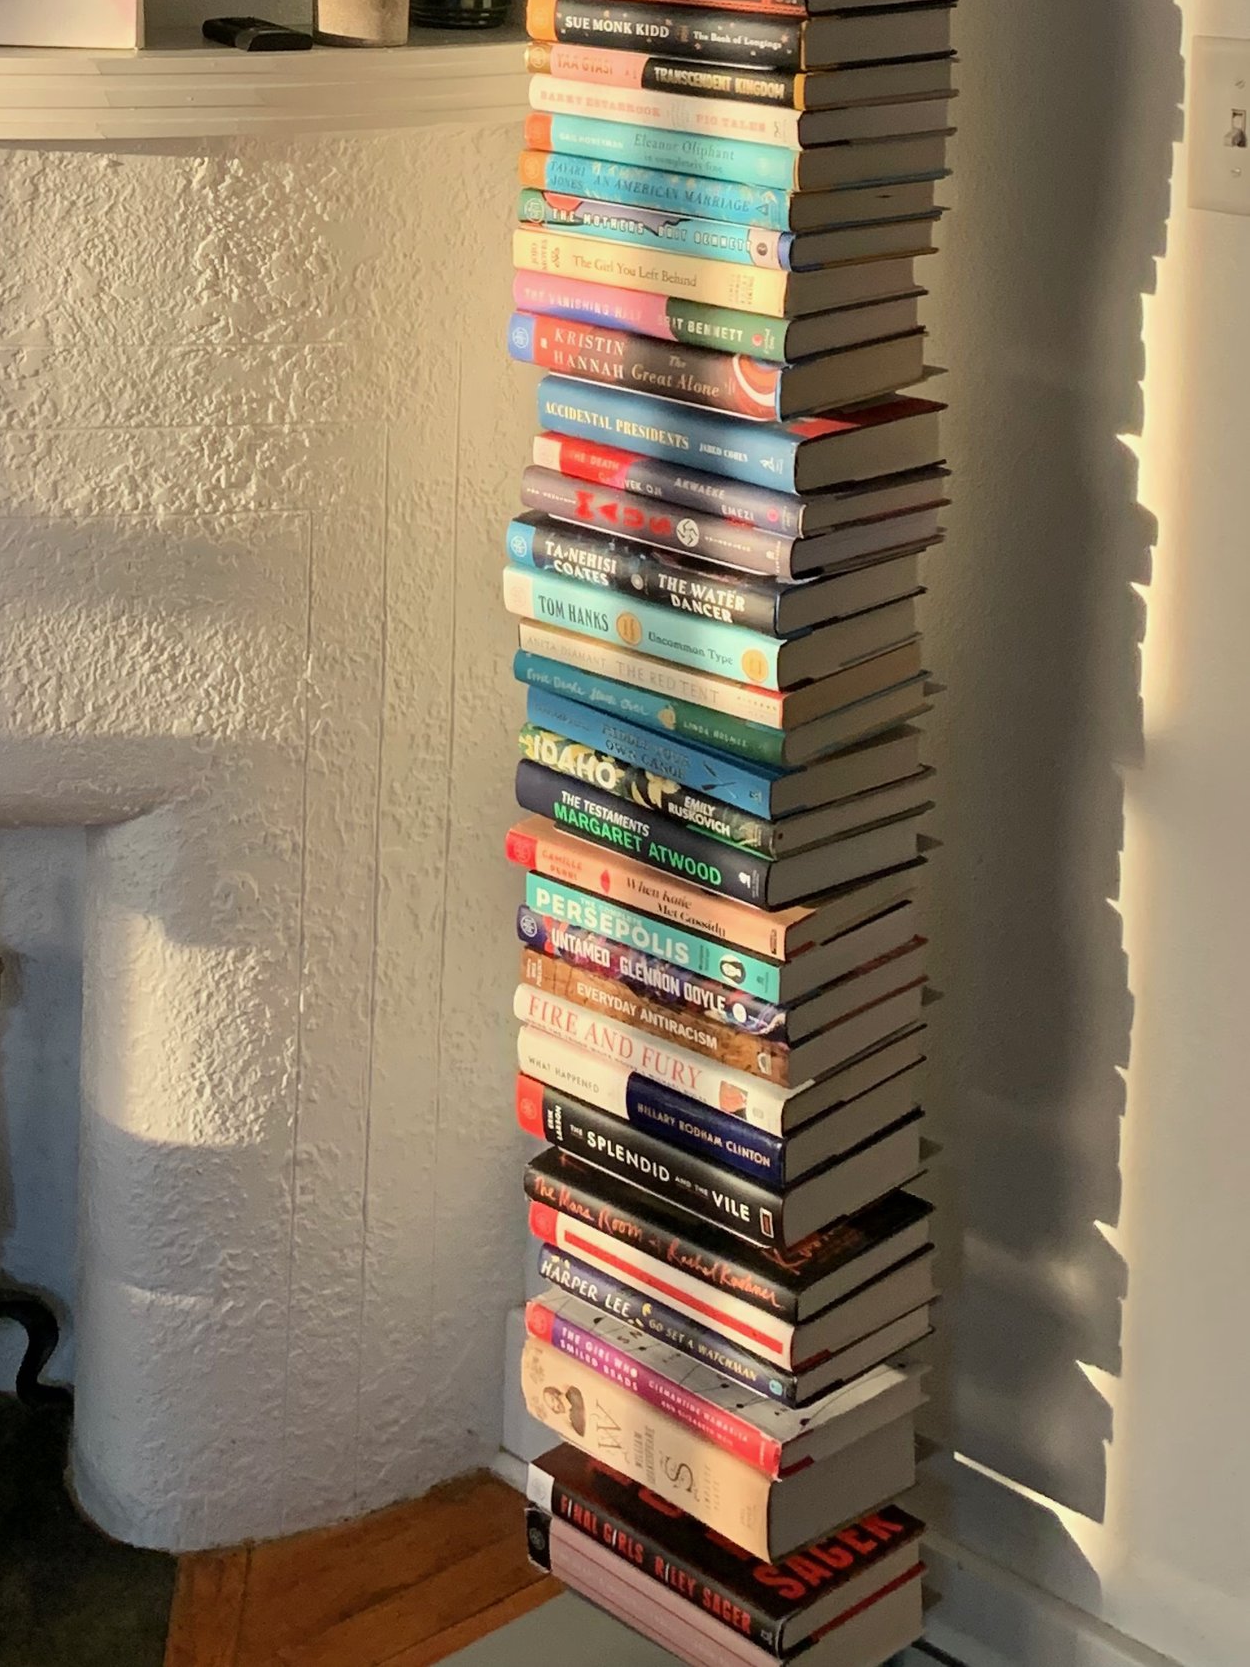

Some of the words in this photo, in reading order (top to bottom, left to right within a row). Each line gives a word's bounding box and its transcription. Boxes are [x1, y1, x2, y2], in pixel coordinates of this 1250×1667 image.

[565, 15, 590, 30] SUE
[592, 19, 632, 35] MONK
[636, 23, 670, 39] KIDD
[693, 30, 709, 41] The
[711, 33, 731, 44] Book
[733, 35, 742, 45] of
[744, 36, 782, 52] Longings
[556, 52, 579, 70] YAA
[654, 66, 733, 92] TRANSCENDENT
[735, 75, 786, 99] KINGDOM
[633, 133, 678, 152] Eleanor
[682, 136, 735, 161] Oliphant
[550, 160, 586, 177] TAYARI
[550, 175, 583, 191] JONES
[593, 175, 612, 190] AN
[614, 178, 680, 201] AMERICAN
[682, 188, 750, 213] MARRIAGE
[552, 208, 576, 223] THE
[582, 213, 645, 235] MOTHERS
[694, 231, 752, 254] BENNETT
[573, 254, 592, 270] The
[593, 257, 614, 272] Girl
[616, 262, 636, 277] You
[639, 266, 659, 281] Left
[661, 269, 697, 288] Behind
[554, 327, 625, 356] KRISTIN
[687, 320, 743, 343] BENNETT
[554, 350, 625, 380] HANNAH
[630, 363, 673, 388] Great
[676, 374, 720, 398] Alone
[668, 355, 687, 369] The
[544, 401, 613, 432] ACCIDENTAL
[616, 420, 689, 451] PRESIDENTS
[674, 477, 726, 500] AKWAEKE
[575, 489, 672, 536] MAUS
[721, 504, 755, 522] EMEZI
[553, 560, 610, 586] COATES
[658, 573, 687, 593] THE
[690, 580, 746, 612] WATER
[671, 594, 734, 624] DANCER
[538, 595, 565, 618] TOM
[568, 600, 609, 633] HANKS
[648, 631, 706, 658] Uncommon
[707, 648, 734, 667] Type
[616, 660, 644, 681] THE
[650, 670, 675, 691] RED
[677, 678, 719, 705] TENT
[533, 734, 618, 790] IDAHO
[561, 791, 581, 807] THE
[583, 798, 650, 837] TESTAMENTS
[667, 804, 731, 837] RUSKOVICH
[683, 795, 717, 816] EMILY
[553, 802, 643, 852] MARGARET
[649, 842, 722, 886] ATWOOD
[625, 876, 660, 898] When
[662, 889, 693, 910] Katie
[656, 902, 679, 920] Met
[536, 887, 690, 965] PERSEPOLIS
[551, 926, 610, 968] UNTAMED
[620, 956, 680, 998] GLENNON
[683, 981, 726, 1013] DOYLE
[577, 982, 637, 1017] EVERYDAY
[640, 1008, 718, 1050] ANTIRACISM
[529, 994, 578, 1034] FIRE
[584, 1022, 634, 1060] AND
[642, 1047, 703, 1089] FURY
[528, 1056, 550, 1074] WHAT
[554, 1066, 600, 1094] HAPPENED
[637, 1102, 676, 1127] HILLARY
[679, 1117, 723, 1147] RODHAM
[725, 1140, 771, 1168] CLINTON
[570, 1123, 583, 1137] THE
[587, 1130, 670, 1183] SPLENDID
[674, 1175, 692, 1189] AND
[693, 1183, 709, 1197] THE
[712, 1190, 750, 1223] VILE
[535, 1176, 556, 1199] The
[559, 1186, 595, 1222] Mars
[598, 1205, 644, 1243] Room
[540, 1261, 599, 1303] HARPER
[605, 1292, 631, 1319] LEE
[559, 1339, 599, 1375] SMILED
[603, 1363, 639, 1392] BEADS
[561, 1326, 581, 1347] THE
[585, 1338, 611, 1364] GIRL
[613, 1354, 639, 1380] WHO
[648, 1318, 664, 1334] GO
[665, 1327, 685, 1345] SET
[686, 1338, 695, 1350] A
[697, 1343, 758, 1383] WATCHMAN
[560, 1492, 598, 1534] FINAL
[603, 1521, 644, 1564] GIRLS
[654, 1554, 697, 1598] RILEY
[702, 1585, 751, 1634] SAGER
[753, 1513, 904, 1600] SAGER
